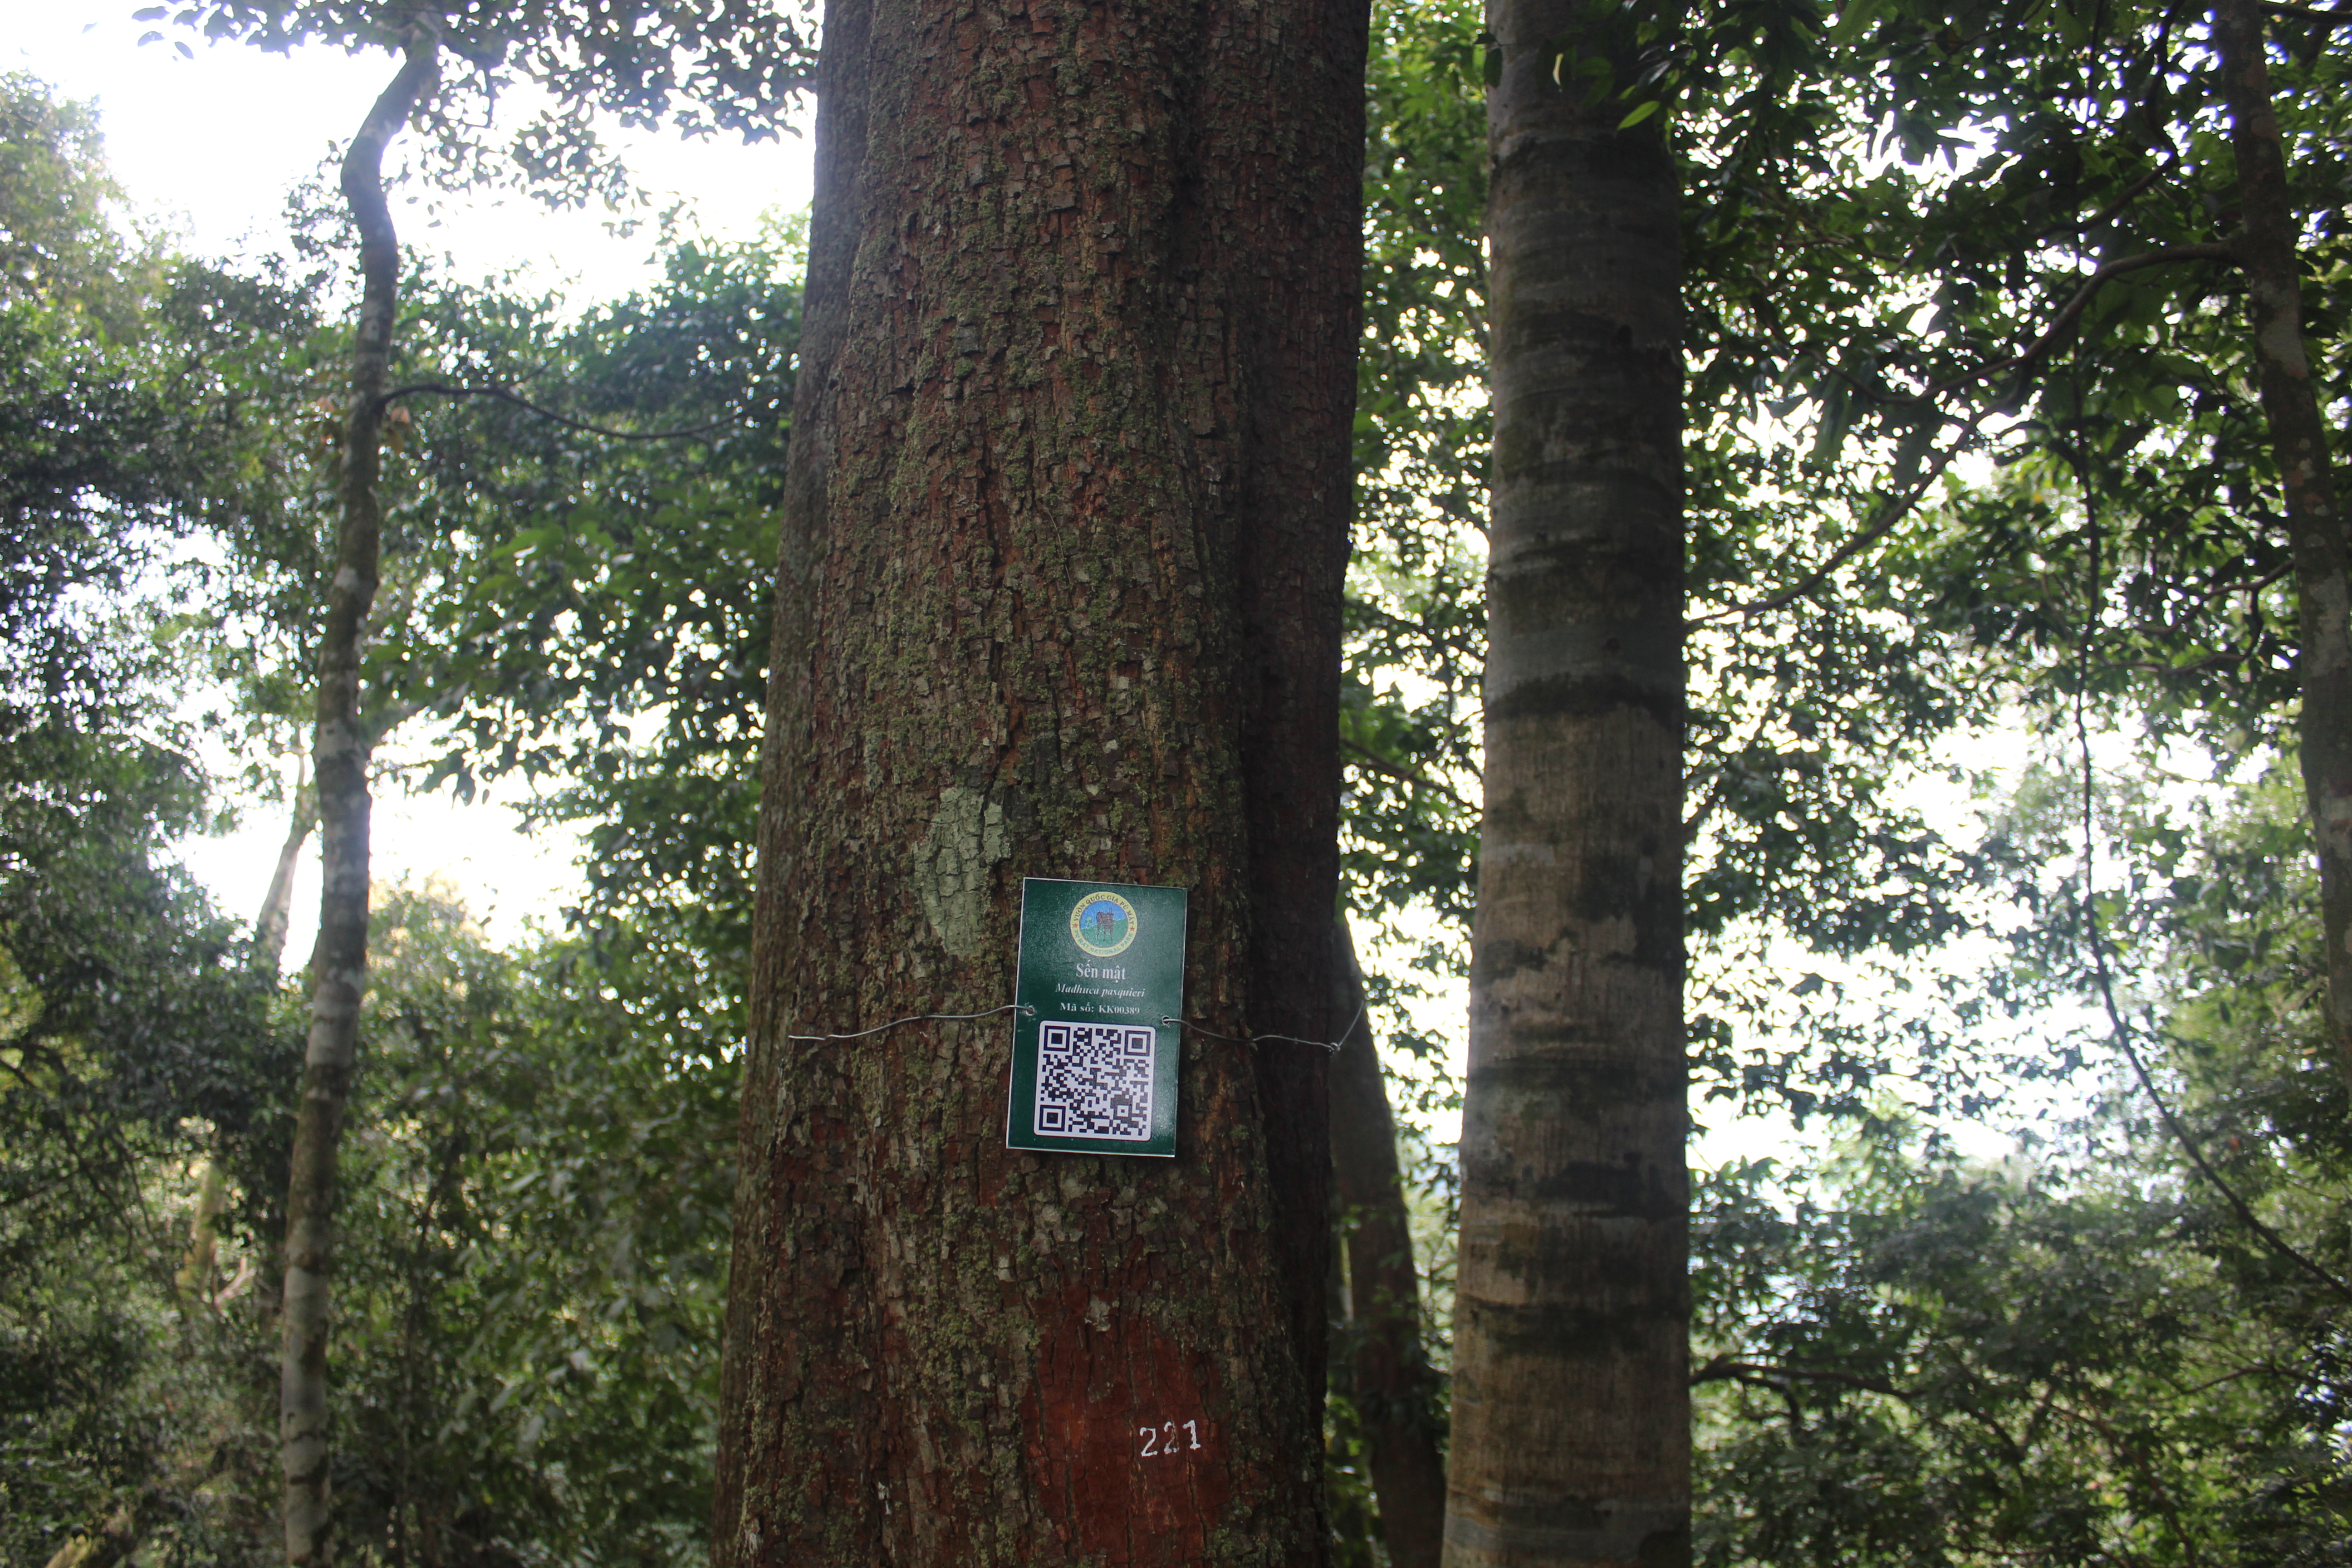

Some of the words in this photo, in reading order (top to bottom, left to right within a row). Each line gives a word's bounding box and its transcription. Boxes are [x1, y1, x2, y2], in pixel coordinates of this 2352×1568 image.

[1085, 893, 1105, 905] QUỐC
[1107, 895, 1119, 903] GIA
[1076, 960, 1098, 979] Sến
[1102, 965, 1127, 984] mật
[1055, 983, 1100, 995] Madhuca
[1101, 987, 1145, 999] pasquieri
[1060, 1002, 1077, 1012] Mã
[1080, 1002, 1094, 1013] số:
[1098, 1004, 1140, 1014] KK00389
[1139, 1420, 1201, 1457] 221
